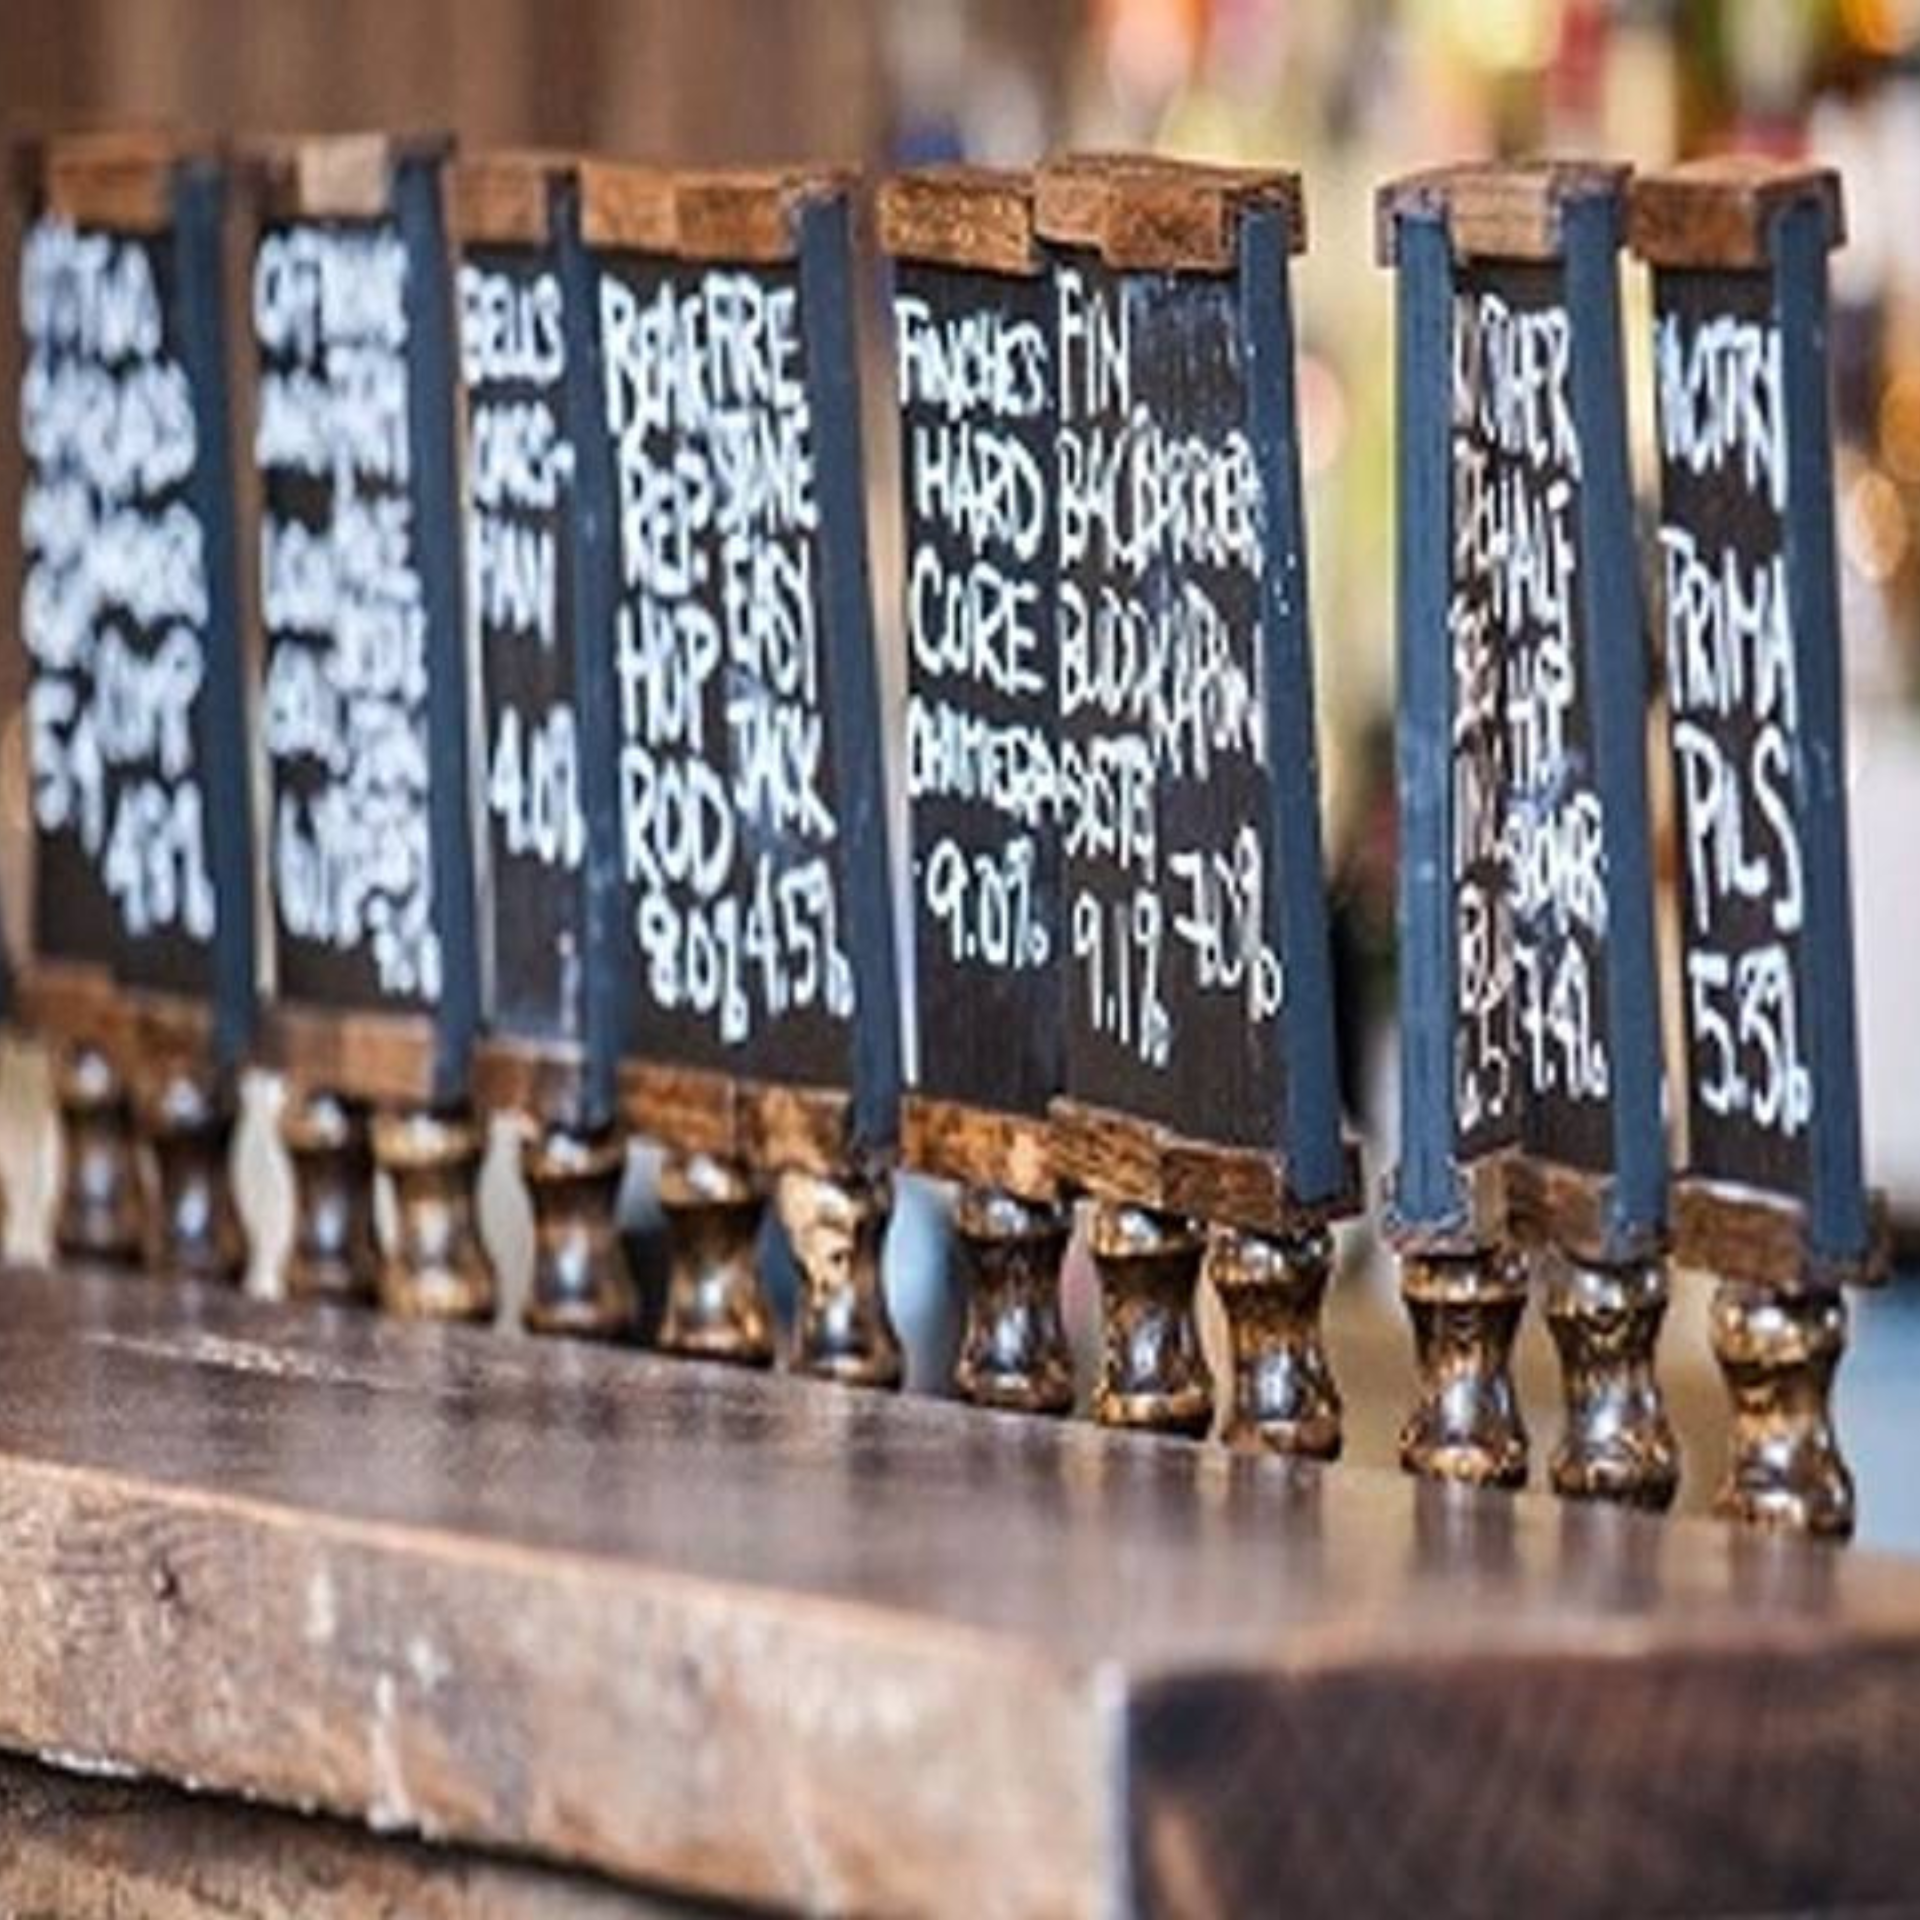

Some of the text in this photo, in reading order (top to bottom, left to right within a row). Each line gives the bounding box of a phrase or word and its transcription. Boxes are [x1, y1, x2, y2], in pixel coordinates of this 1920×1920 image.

[1055, 268, 1131, 422] FIN
[914, 420, 1045, 561] HARD
[615, 598, 721, 756] HOP
[909, 543, 1042, 696] CORE
[620, 742, 735, 898] ROD
[1673, 722, 1804, 934] PILS
